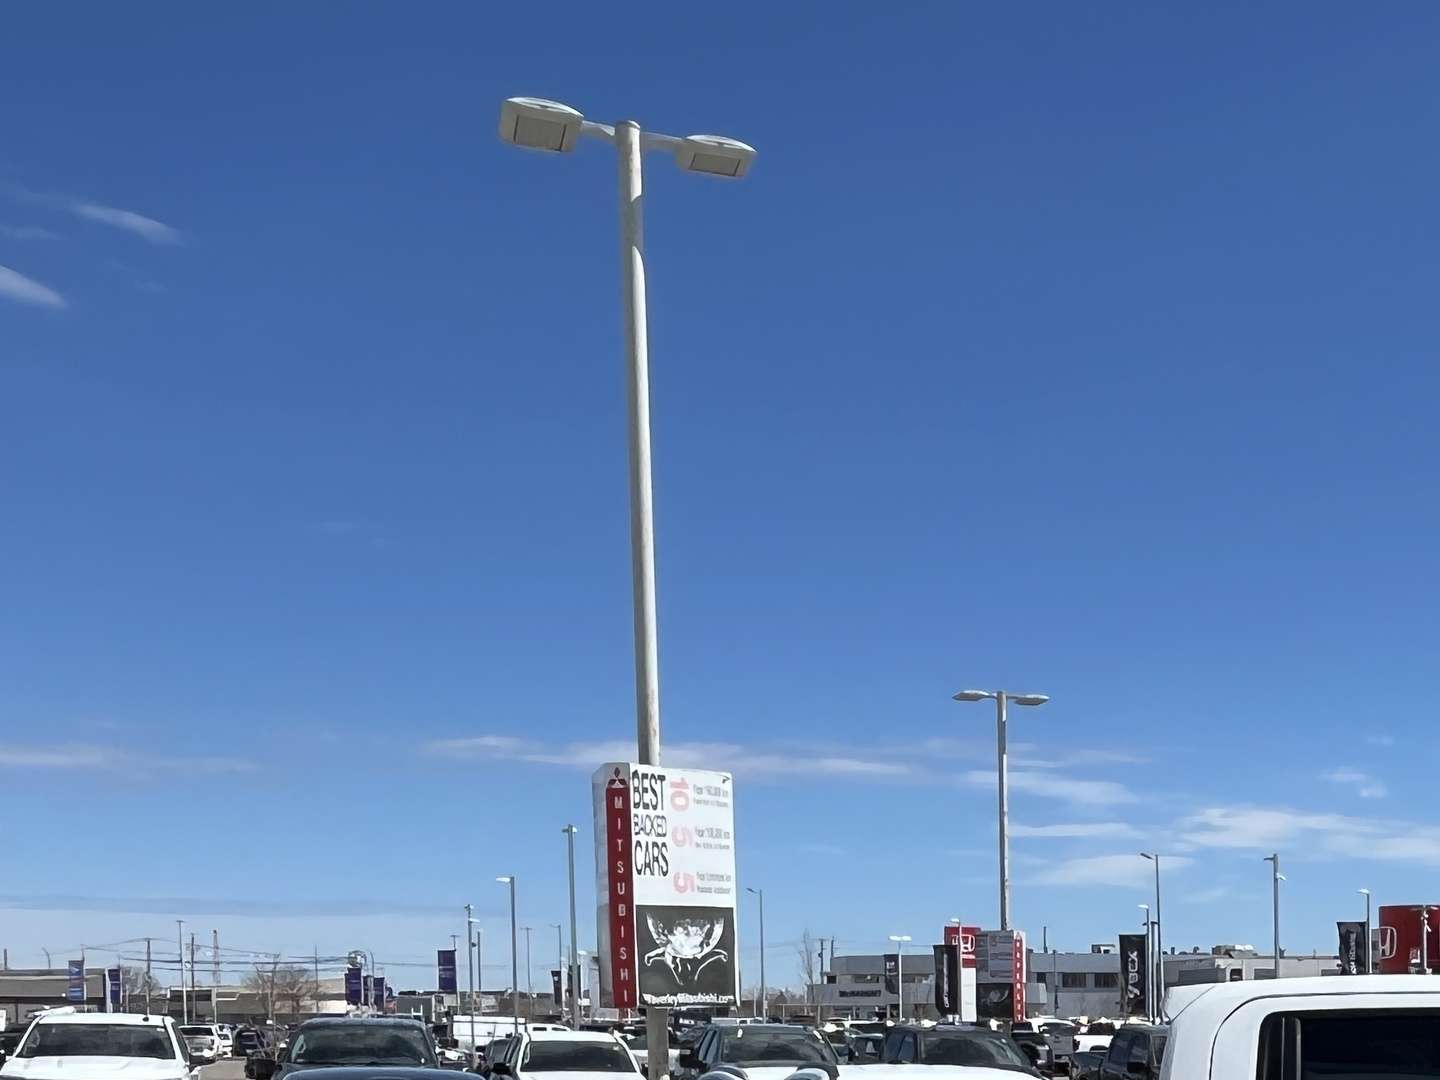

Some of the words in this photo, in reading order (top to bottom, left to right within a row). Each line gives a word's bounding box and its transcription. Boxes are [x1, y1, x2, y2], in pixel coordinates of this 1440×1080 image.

[632, 770, 666, 811] BEST
[634, 813, 667, 837] BACKED
[634, 840, 669, 877] CARS
[613, 796, 629, 1003] MITSUBISHI
